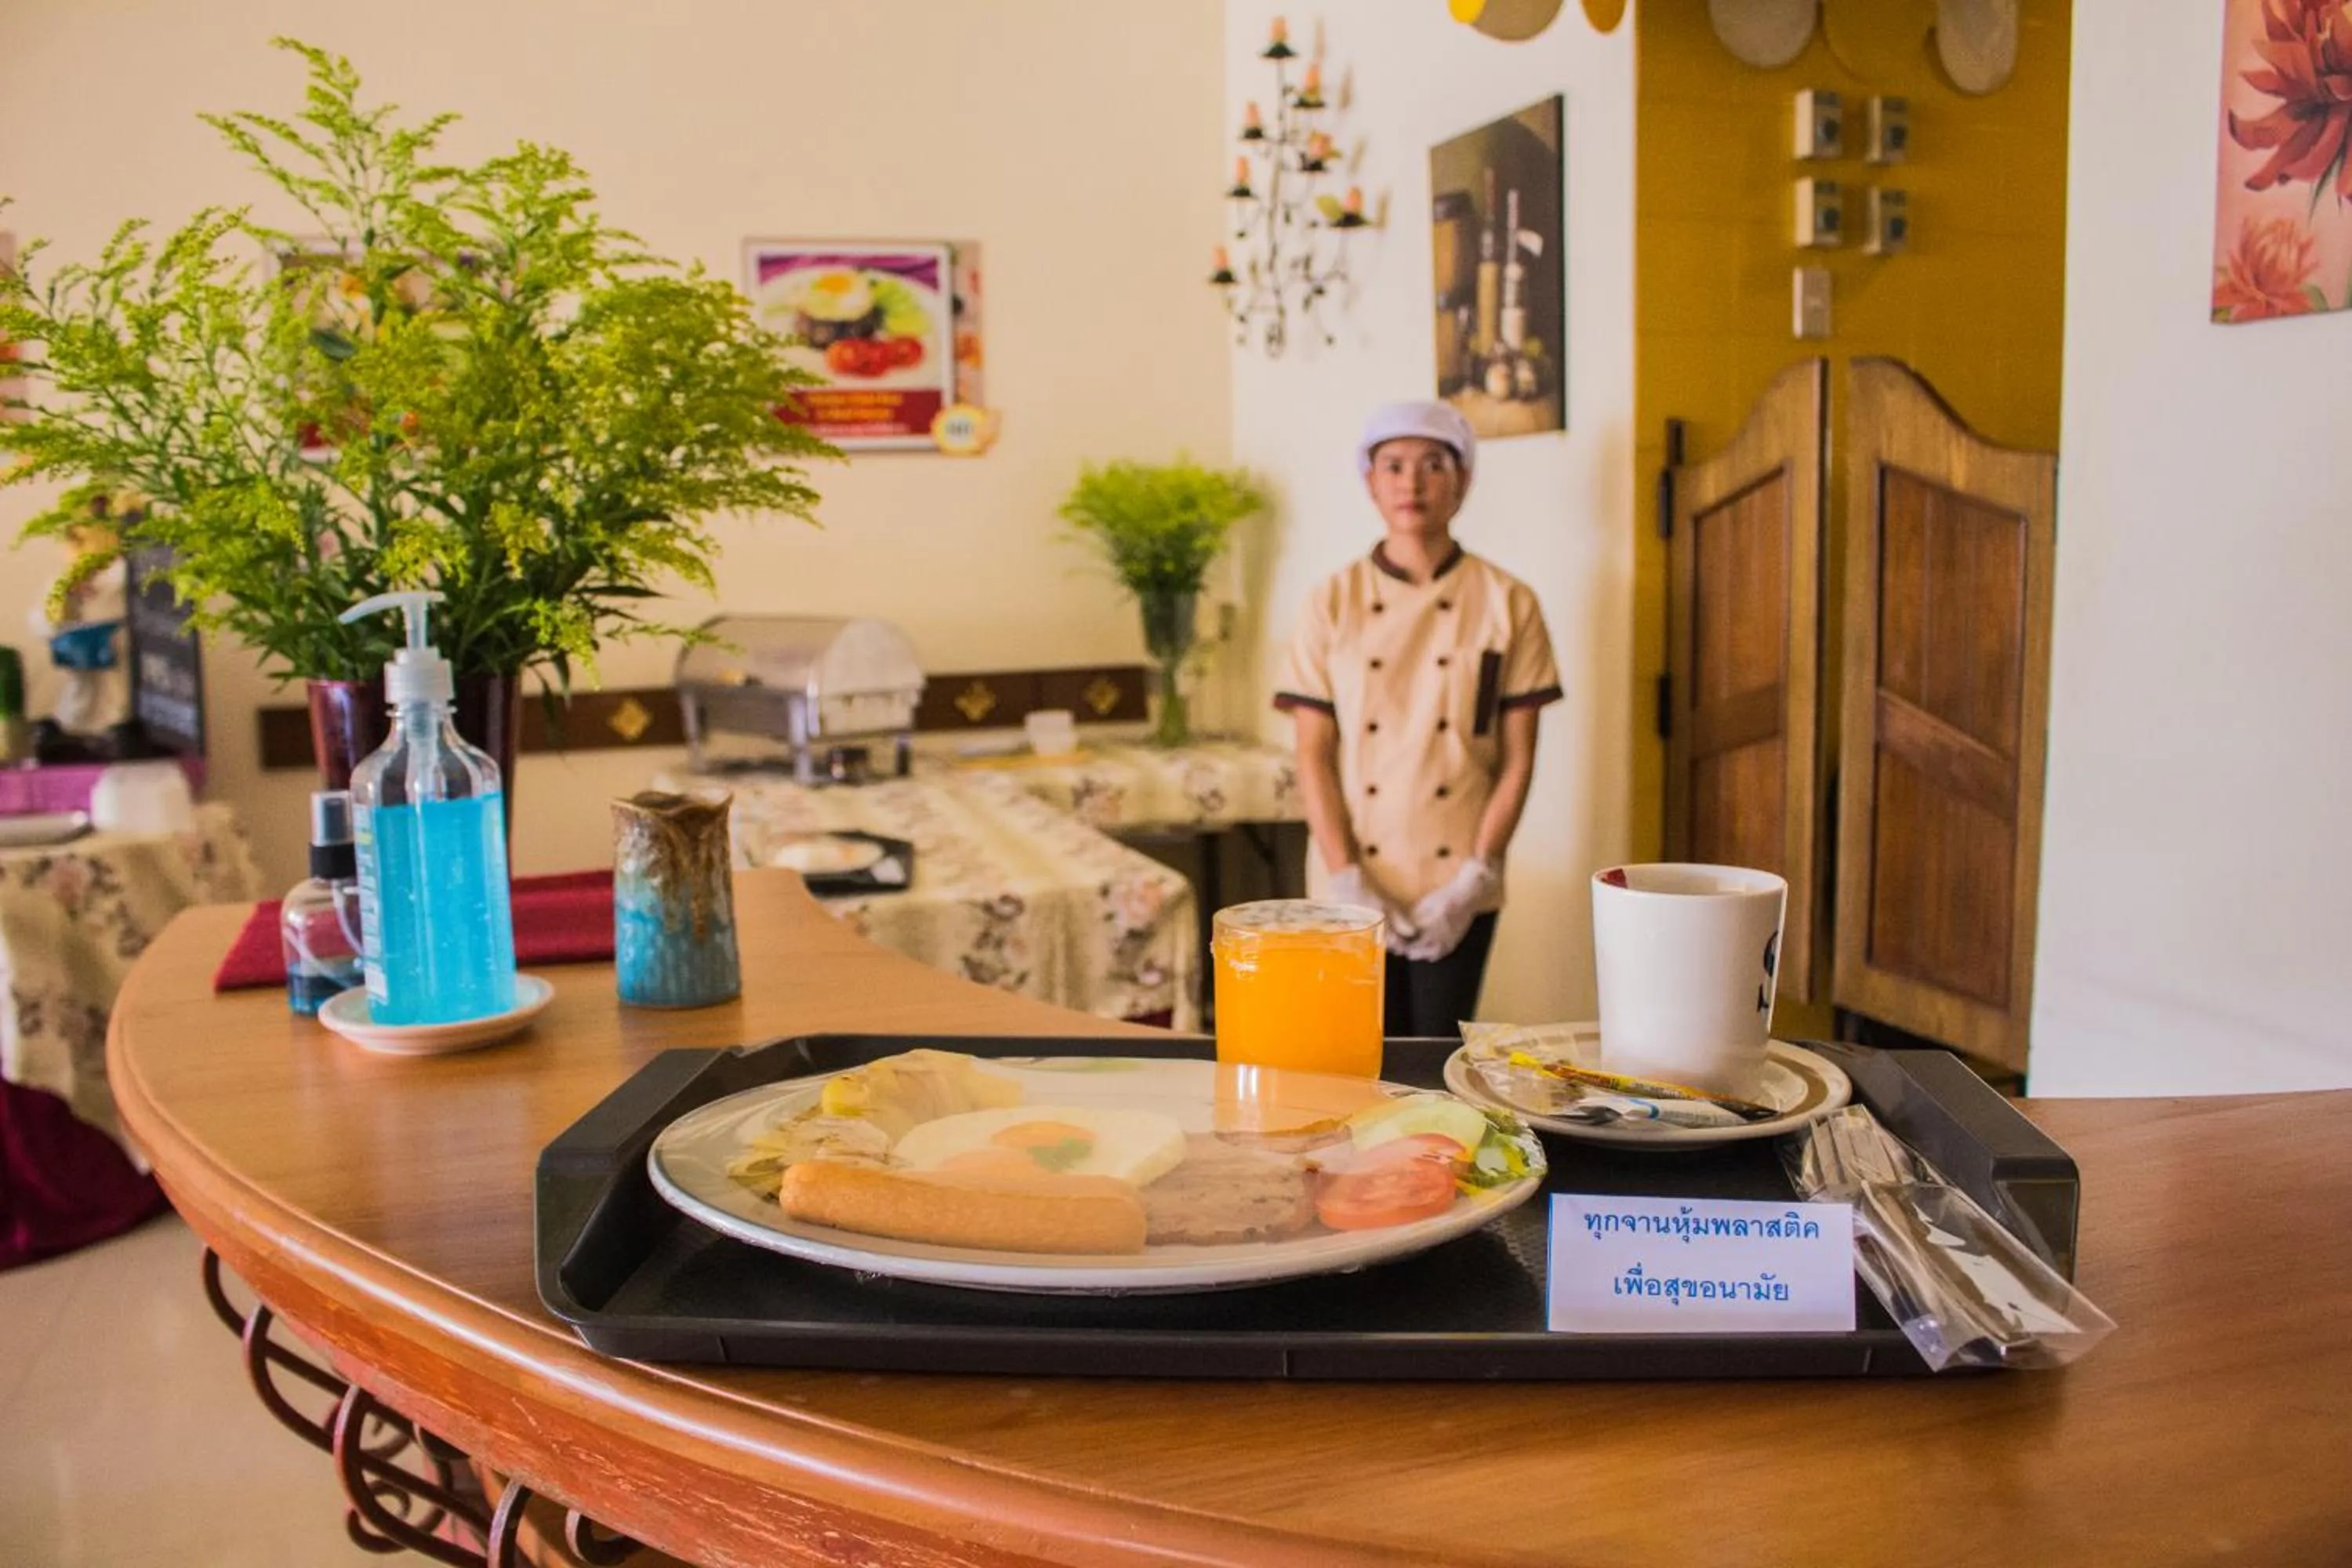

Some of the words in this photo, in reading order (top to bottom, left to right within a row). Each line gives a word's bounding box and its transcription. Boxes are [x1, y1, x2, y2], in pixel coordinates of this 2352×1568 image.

[1584, 1206, 1820, 1244] ทุกจานหุ้มพลาสติค
[1613, 1263, 1789, 1306] เพื่อสุขอนามัย
